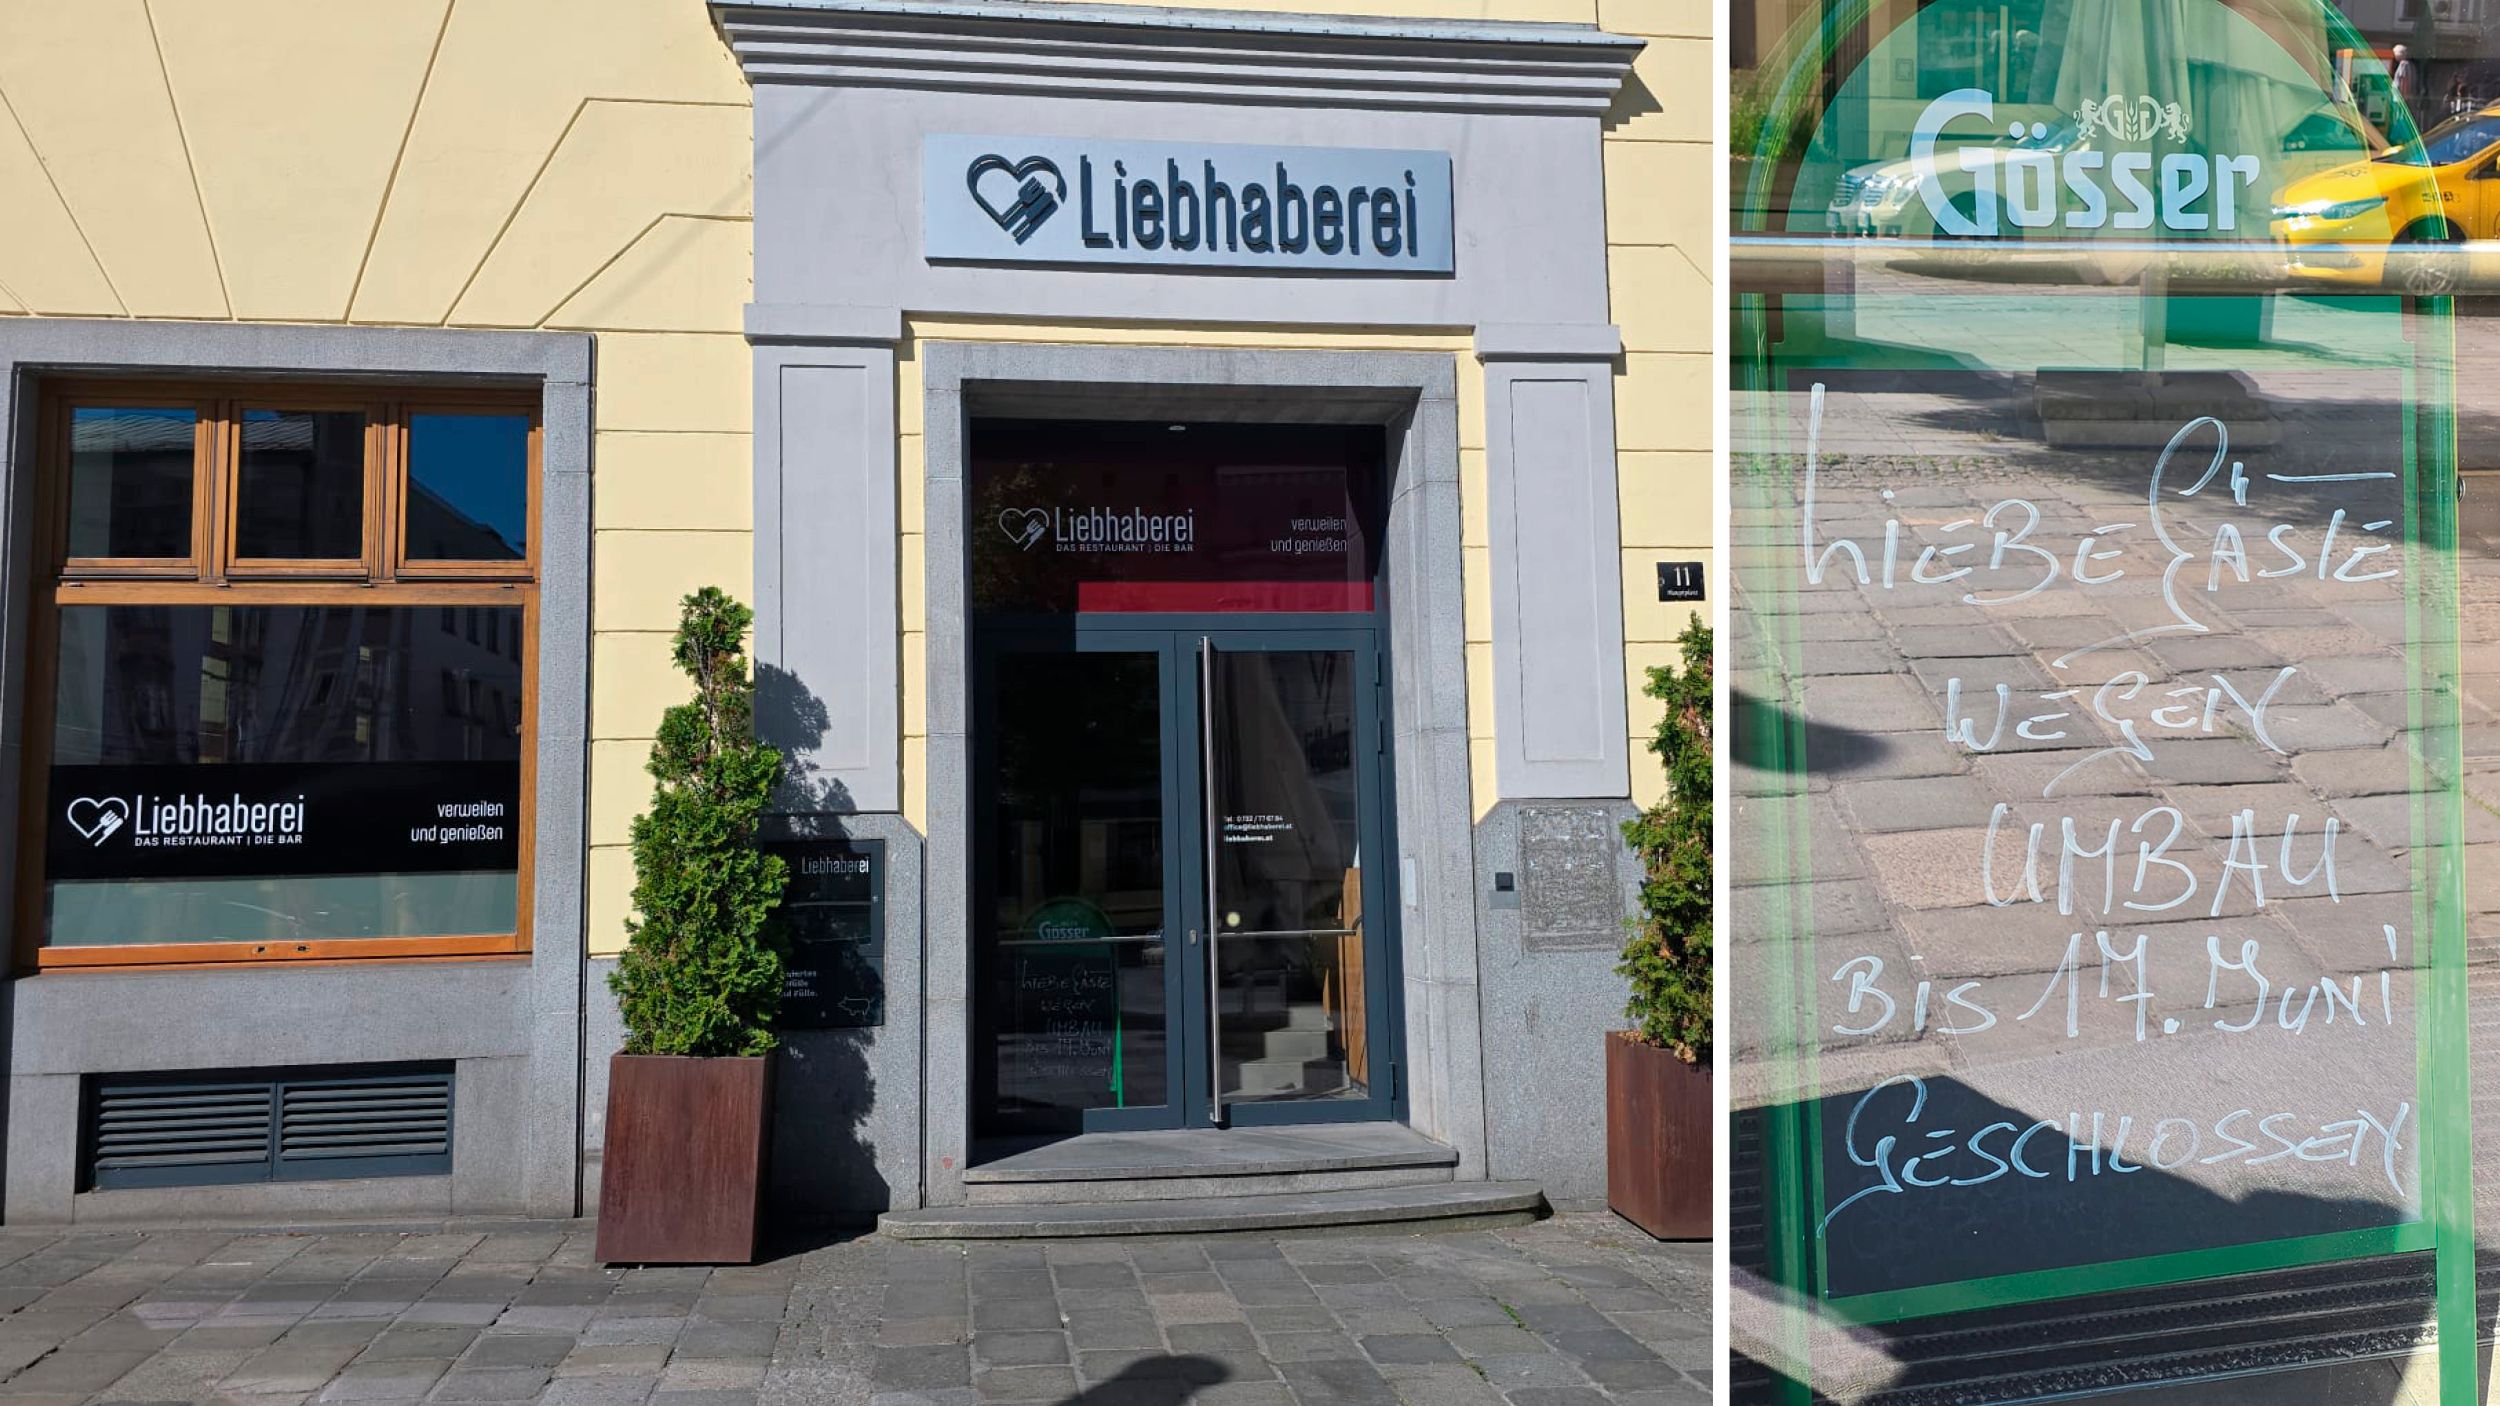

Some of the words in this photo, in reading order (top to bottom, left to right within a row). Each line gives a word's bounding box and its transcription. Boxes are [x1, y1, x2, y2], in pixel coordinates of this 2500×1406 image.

[1910, 88, 2260, 236] Gösser
[1080, 154, 1418, 257] Liebhaberei
[1055, 506, 1193, 542] Liebhaberei
[1291, 518, 1346, 531] verweilen
[1056, 543, 1076, 552] DAS
[1079, 543, 1144, 552] RESTAURANT
[1154, 543, 1170, 552] DIE
[1173, 543, 1193, 552] BAR
[1271, 537, 1291, 551] und
[1295, 538, 1346, 554] genießen
[1673, 567, 1690, 587] 11
[135, 793, 304, 835] Liebhaberei
[437, 801, 504, 818] verweilen
[134, 836, 159, 847] DAS
[163, 835, 242, 846] RESTAURANT
[254, 835, 274, 845] DIE
[278, 834, 303, 845] BAR
[411, 824, 436, 842] und
[440, 824, 504, 844] genießen
[802, 856, 869, 875] Liebhaberei
[1983, 803, 2340, 917] UMBAU
[1816, 1074, 2410, 1238] GESCHLOSSEN
